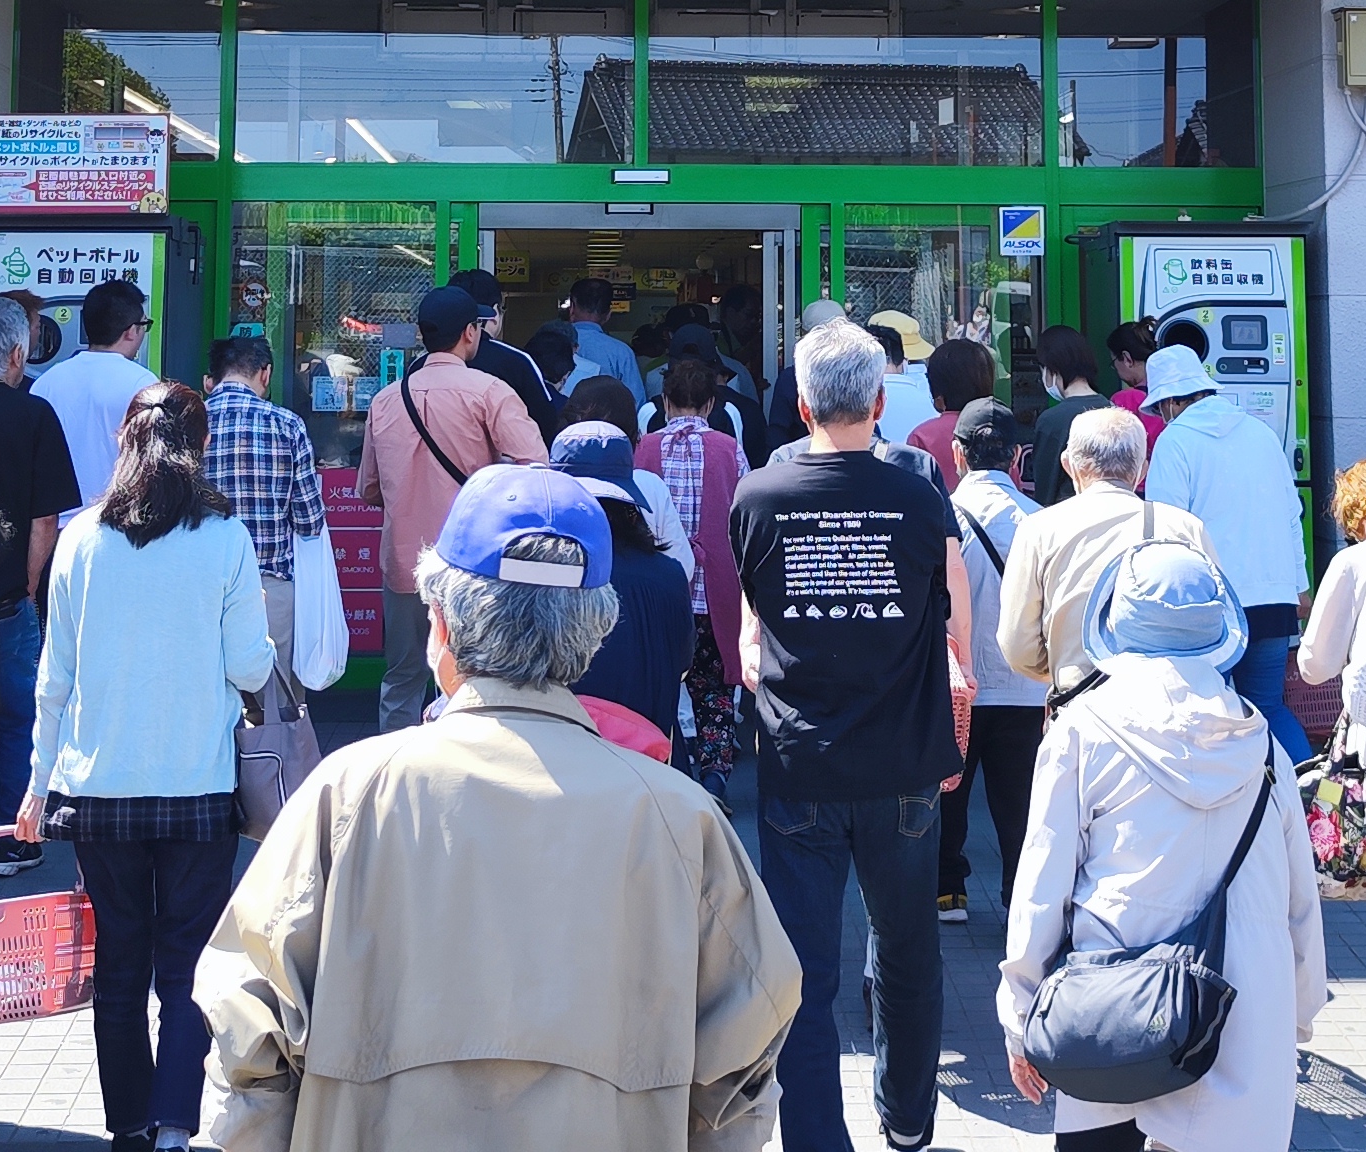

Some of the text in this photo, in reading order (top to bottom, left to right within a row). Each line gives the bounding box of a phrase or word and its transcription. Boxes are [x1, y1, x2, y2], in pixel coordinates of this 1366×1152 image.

[1004, 240, 1041, 248] ALSOK
[36, 247, 140, 264] ペットボトル
[1190, 258, 1233, 271] 飲料缶
[37, 268, 139, 285] 自動回収機
[1191, 273, 1264, 286] 自動回収機
[59, 308, 68, 318] 2
[1202, 309, 1210, 319] 2
[775, 513, 789, 521] The
[790, 511, 821, 520] Original
[868, 510, 903, 520] Company
[818, 520, 841, 528] Since
[342, 566, 374, 574] SMOKING
[812, 570, 823, 578] and
